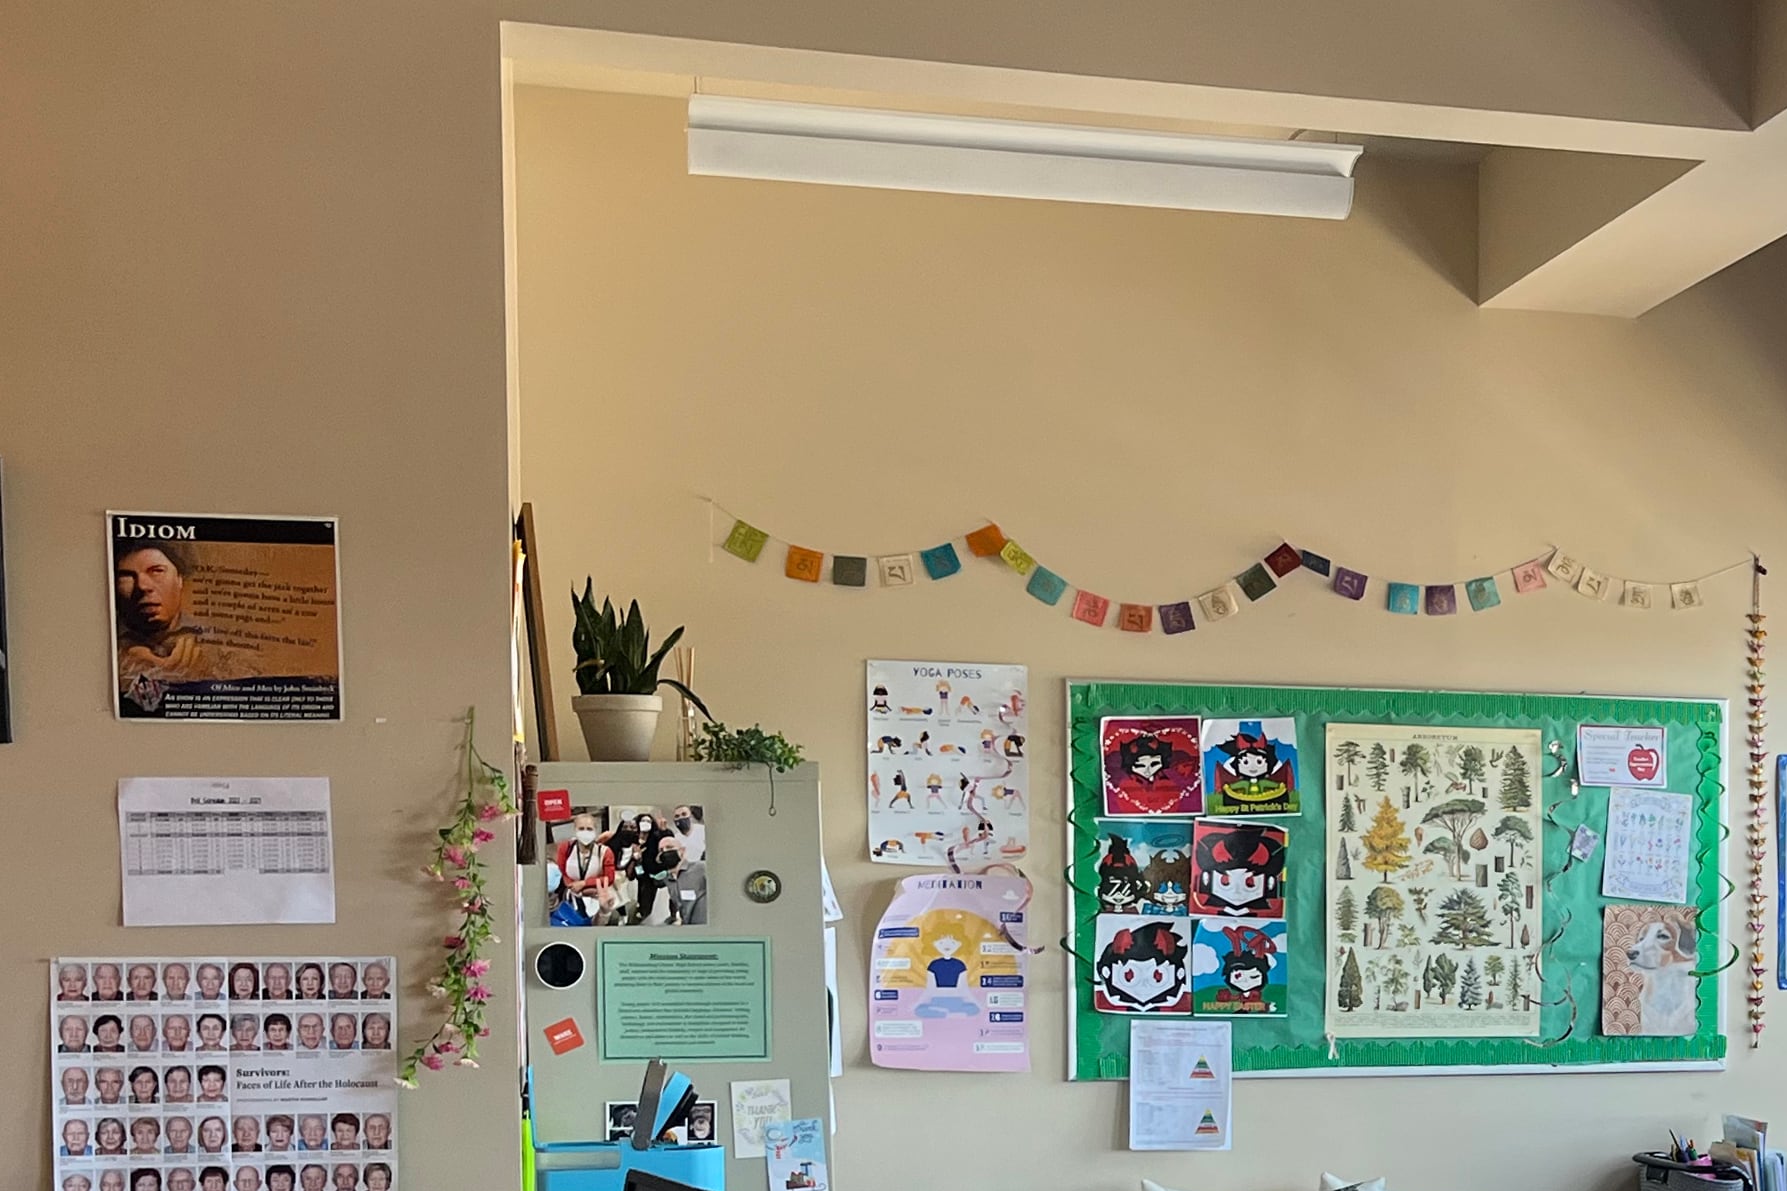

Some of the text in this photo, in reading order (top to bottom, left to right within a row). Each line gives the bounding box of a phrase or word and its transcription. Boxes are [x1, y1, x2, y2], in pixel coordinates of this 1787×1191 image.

[913, 668, 982, 679] YOGA POSES
[1215, 805, 1240, 814] Happy
[1251, 804, 1282, 812] Patrick's
[1283, 803, 1298, 812] Day
[918, 880, 983, 890] MEDITATION
[1202, 1002, 1232, 1010] HAPPY
[236, 1067, 290, 1077] Survivors:
[236, 1080, 378, 1089] Faces of Life After the Holocaust
